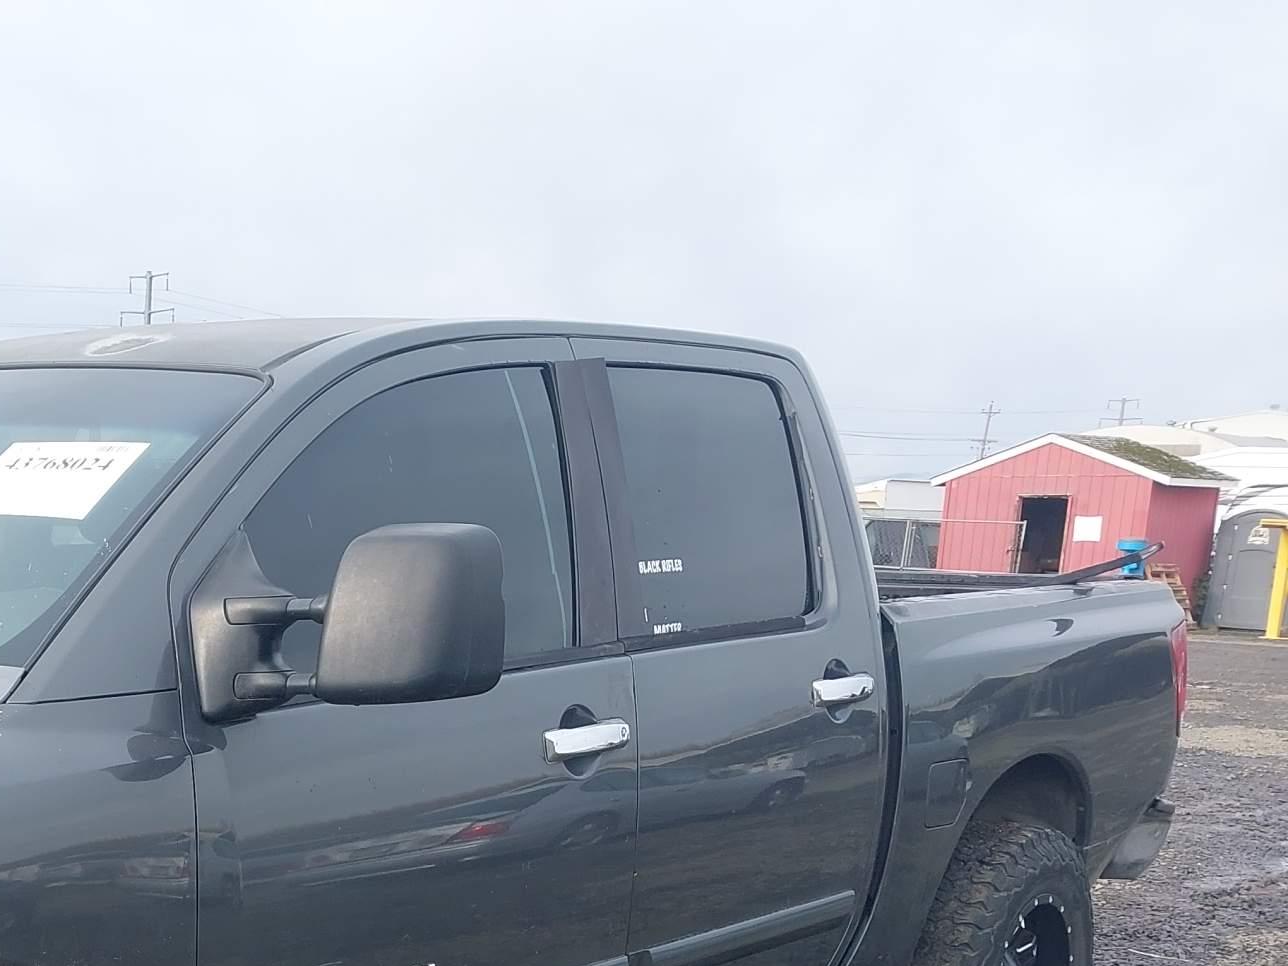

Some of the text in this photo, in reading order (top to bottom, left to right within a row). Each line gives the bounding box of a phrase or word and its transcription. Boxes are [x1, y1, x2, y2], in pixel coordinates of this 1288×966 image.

[5, 457, 114, 471] 43768024
[638, 559, 683, 574] BLACK RIFLES
